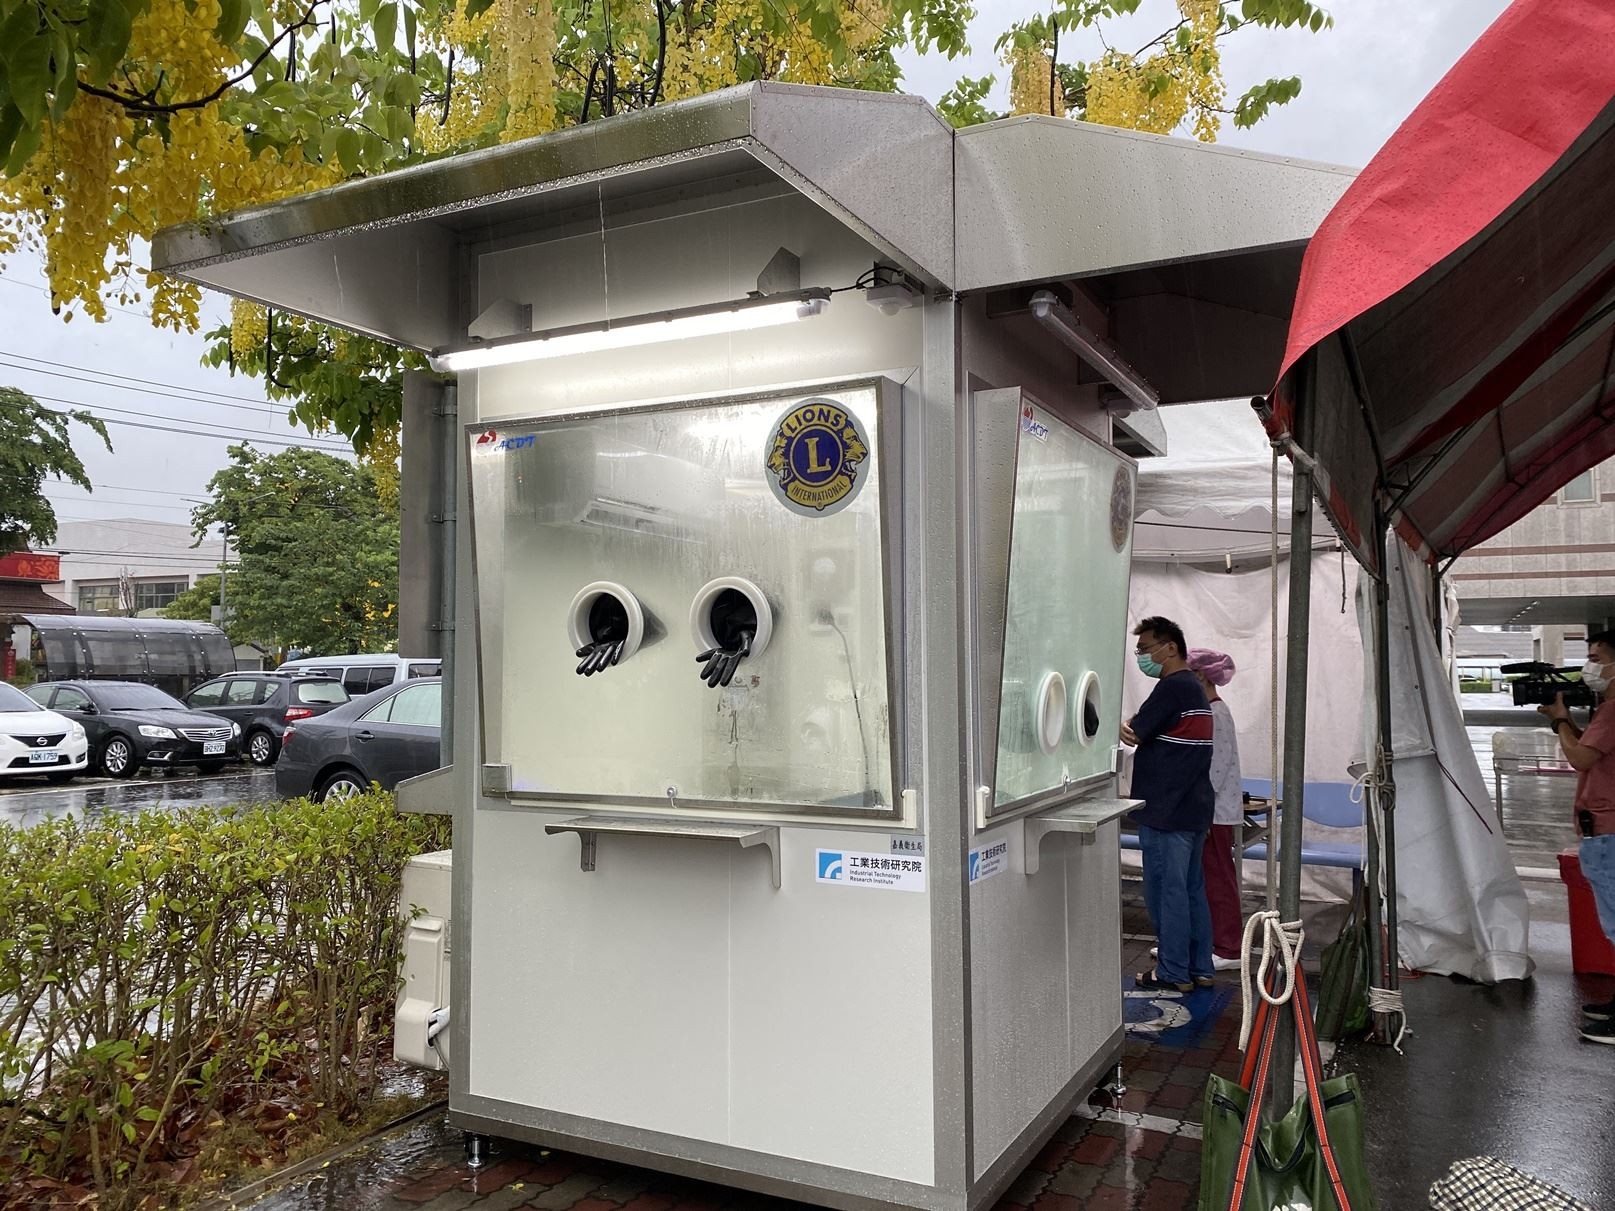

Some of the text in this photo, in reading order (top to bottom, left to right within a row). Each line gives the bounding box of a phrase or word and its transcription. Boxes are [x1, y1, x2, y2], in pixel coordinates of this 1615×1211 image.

[785, 407, 842, 433] LIONS
[494, 434, 536, 452] ACDT
[804, 437, 832, 474] L
[791, 480, 848, 501] INTERNATIONAL
[849, 856, 922, 873] 工業技術研究院
[849, 869, 902, 880] Industrial Technology
